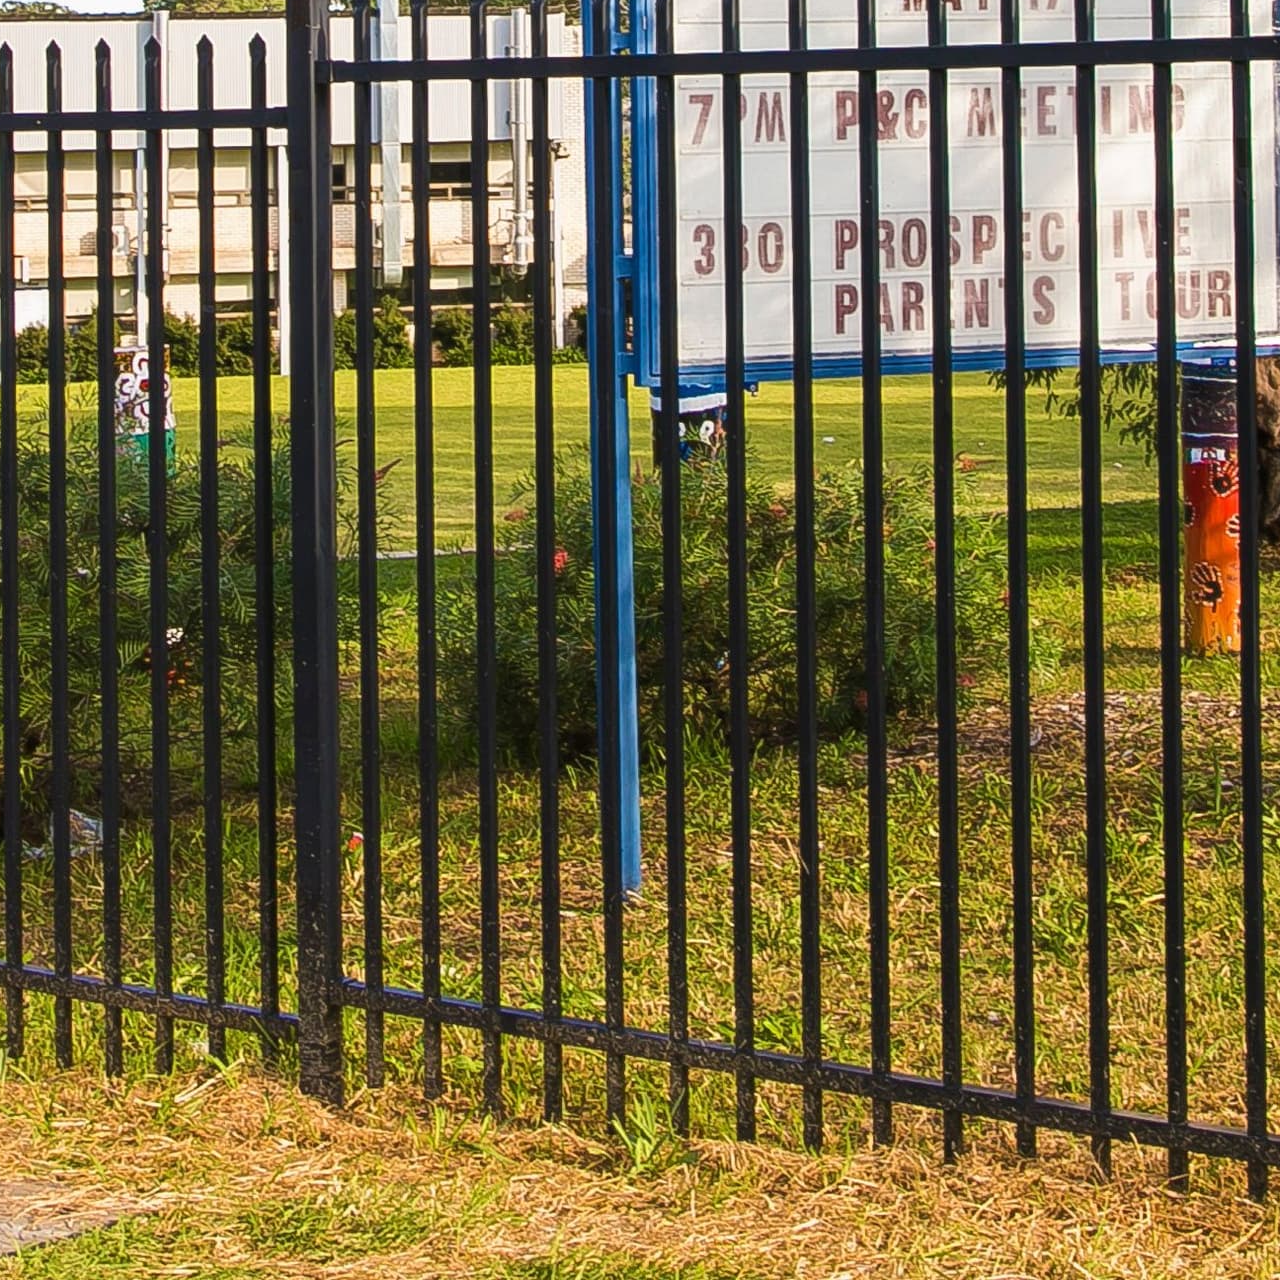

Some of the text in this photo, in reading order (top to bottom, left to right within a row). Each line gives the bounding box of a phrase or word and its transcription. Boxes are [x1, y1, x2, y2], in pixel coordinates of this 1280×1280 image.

[835, 88, 927, 141] P&C
[967, 84, 1184, 137] MEIN
[692, 207, 1191, 275] 30 PROSPCIVE
[835, 275, 1056, 334] PARNS
